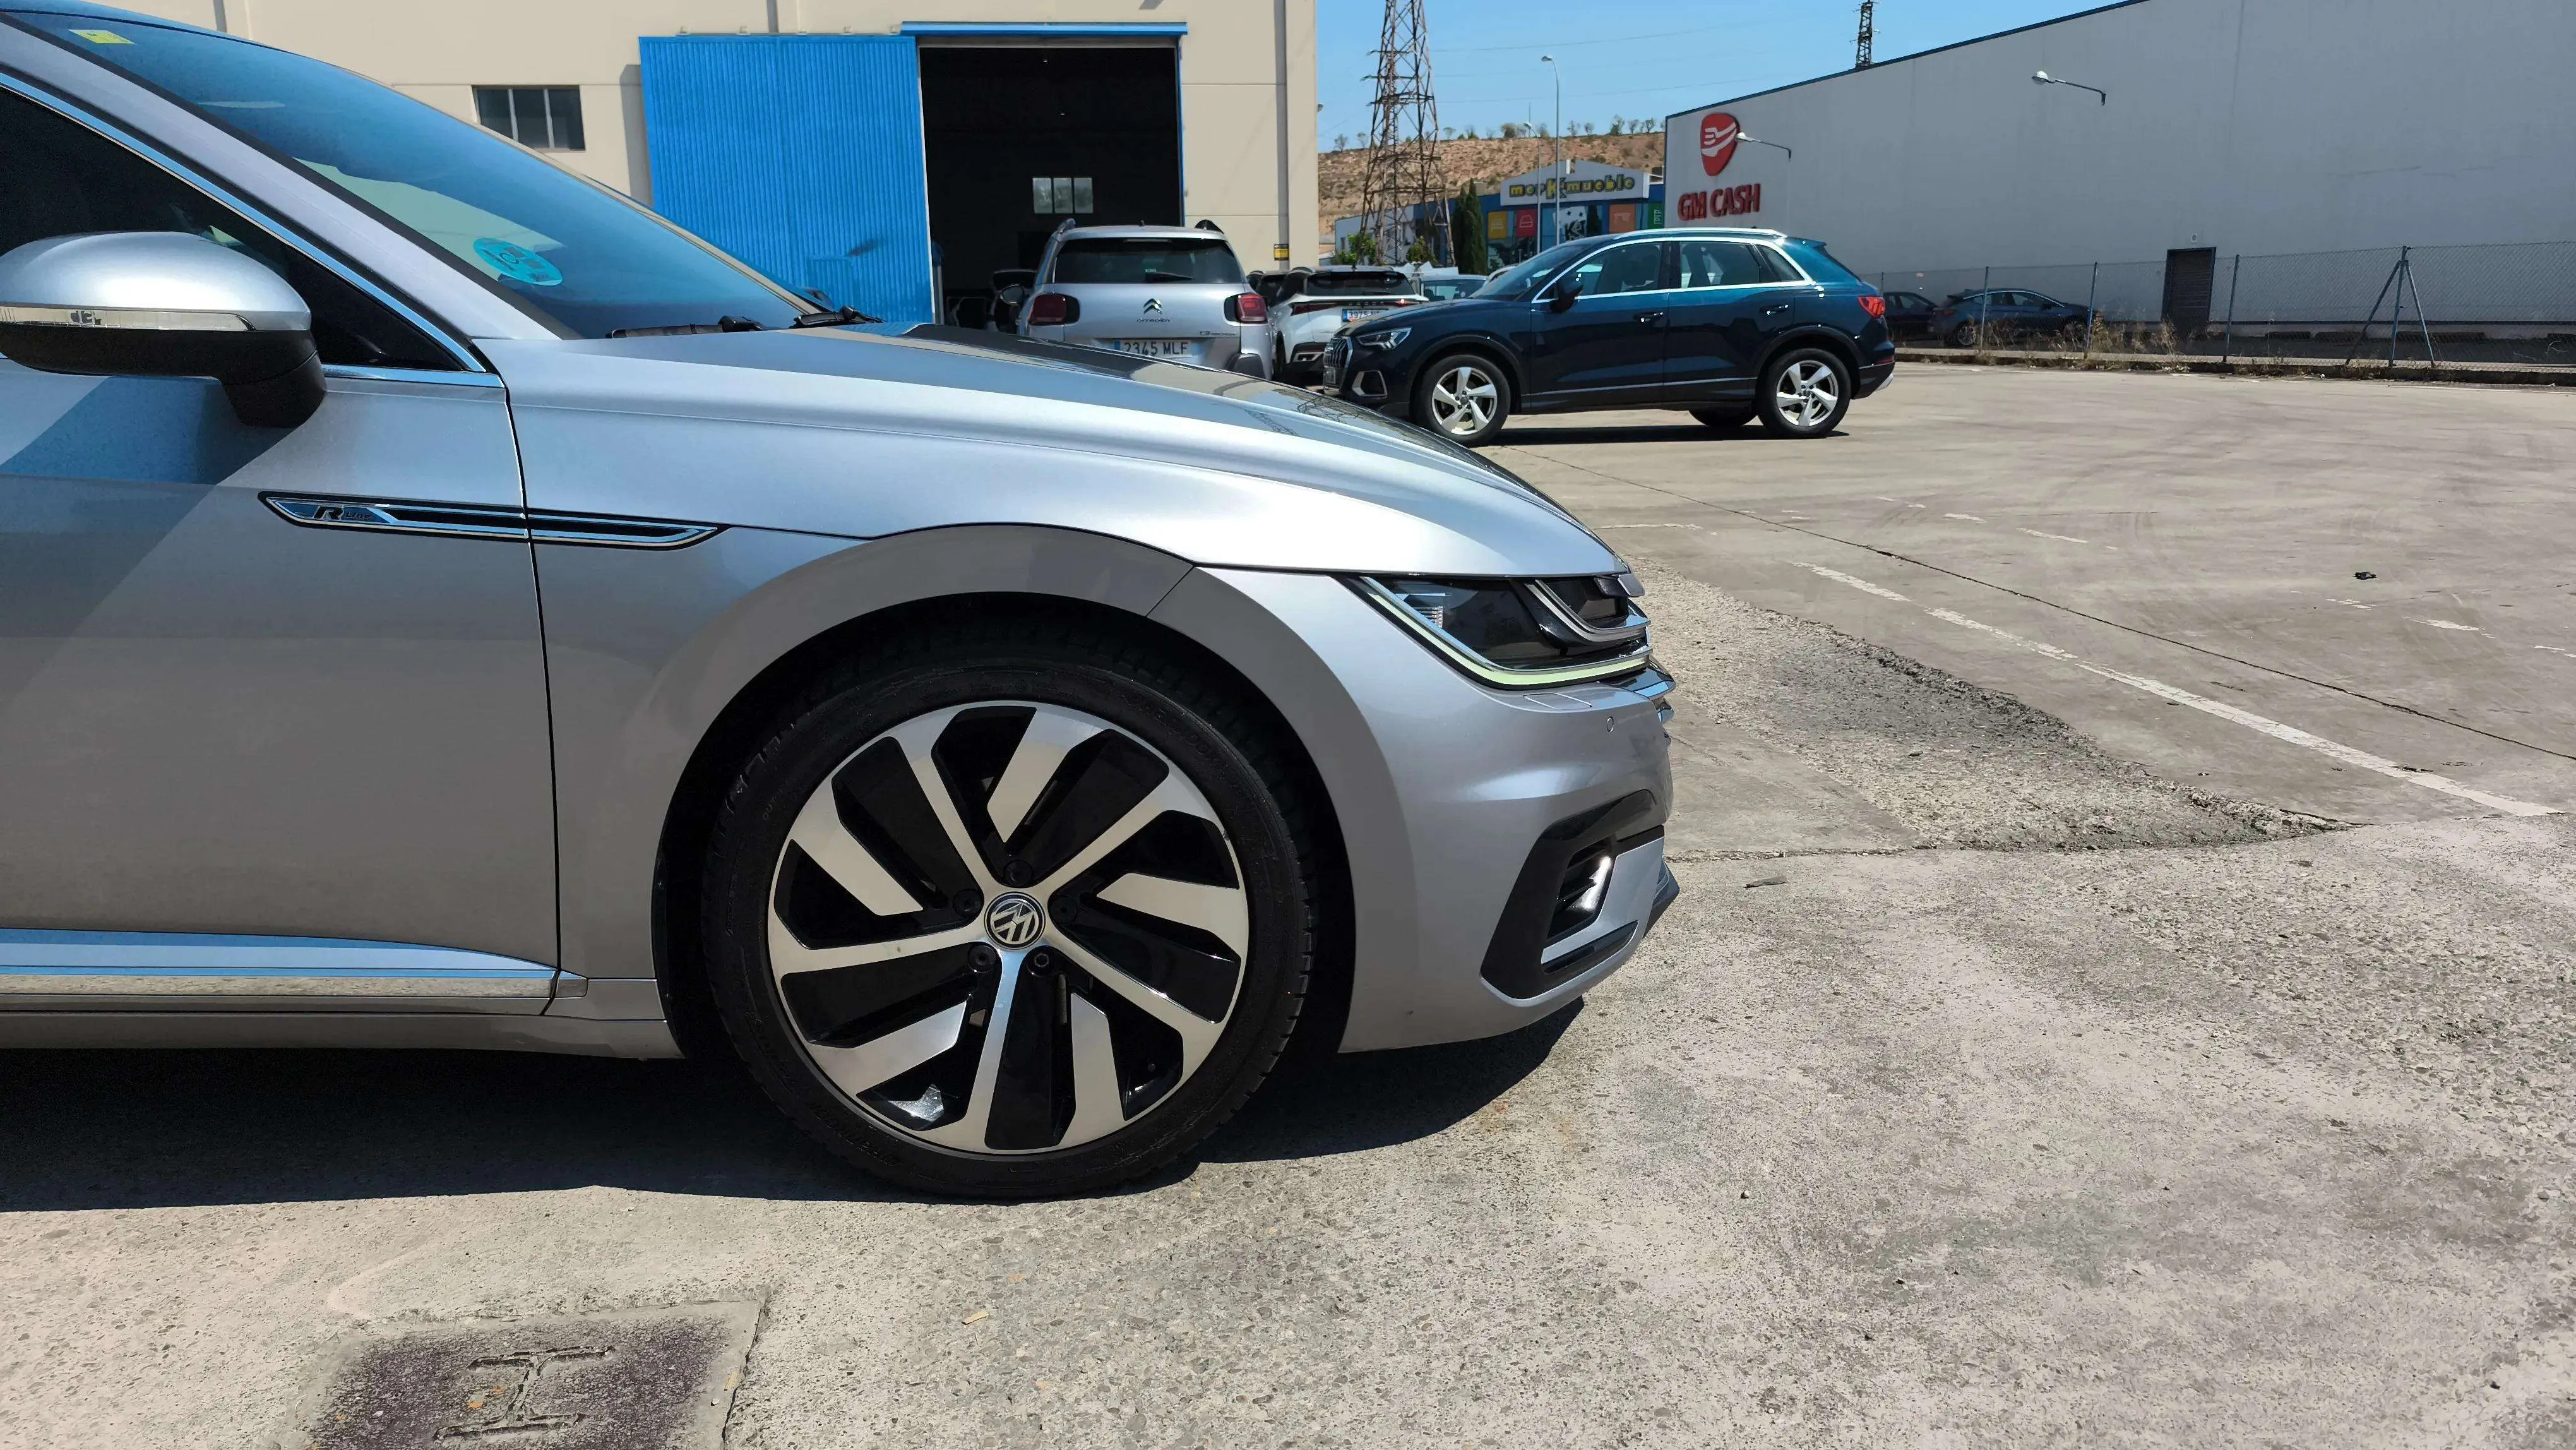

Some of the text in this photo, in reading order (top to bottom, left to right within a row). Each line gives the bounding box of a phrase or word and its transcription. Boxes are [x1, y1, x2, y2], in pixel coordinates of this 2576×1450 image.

[1678, 191, 1707, 221] GM
[1710, 184, 1760, 217] CASH
[1124, 341, 1188, 356] 2345 MLF
[313, 506, 345, 520] R
